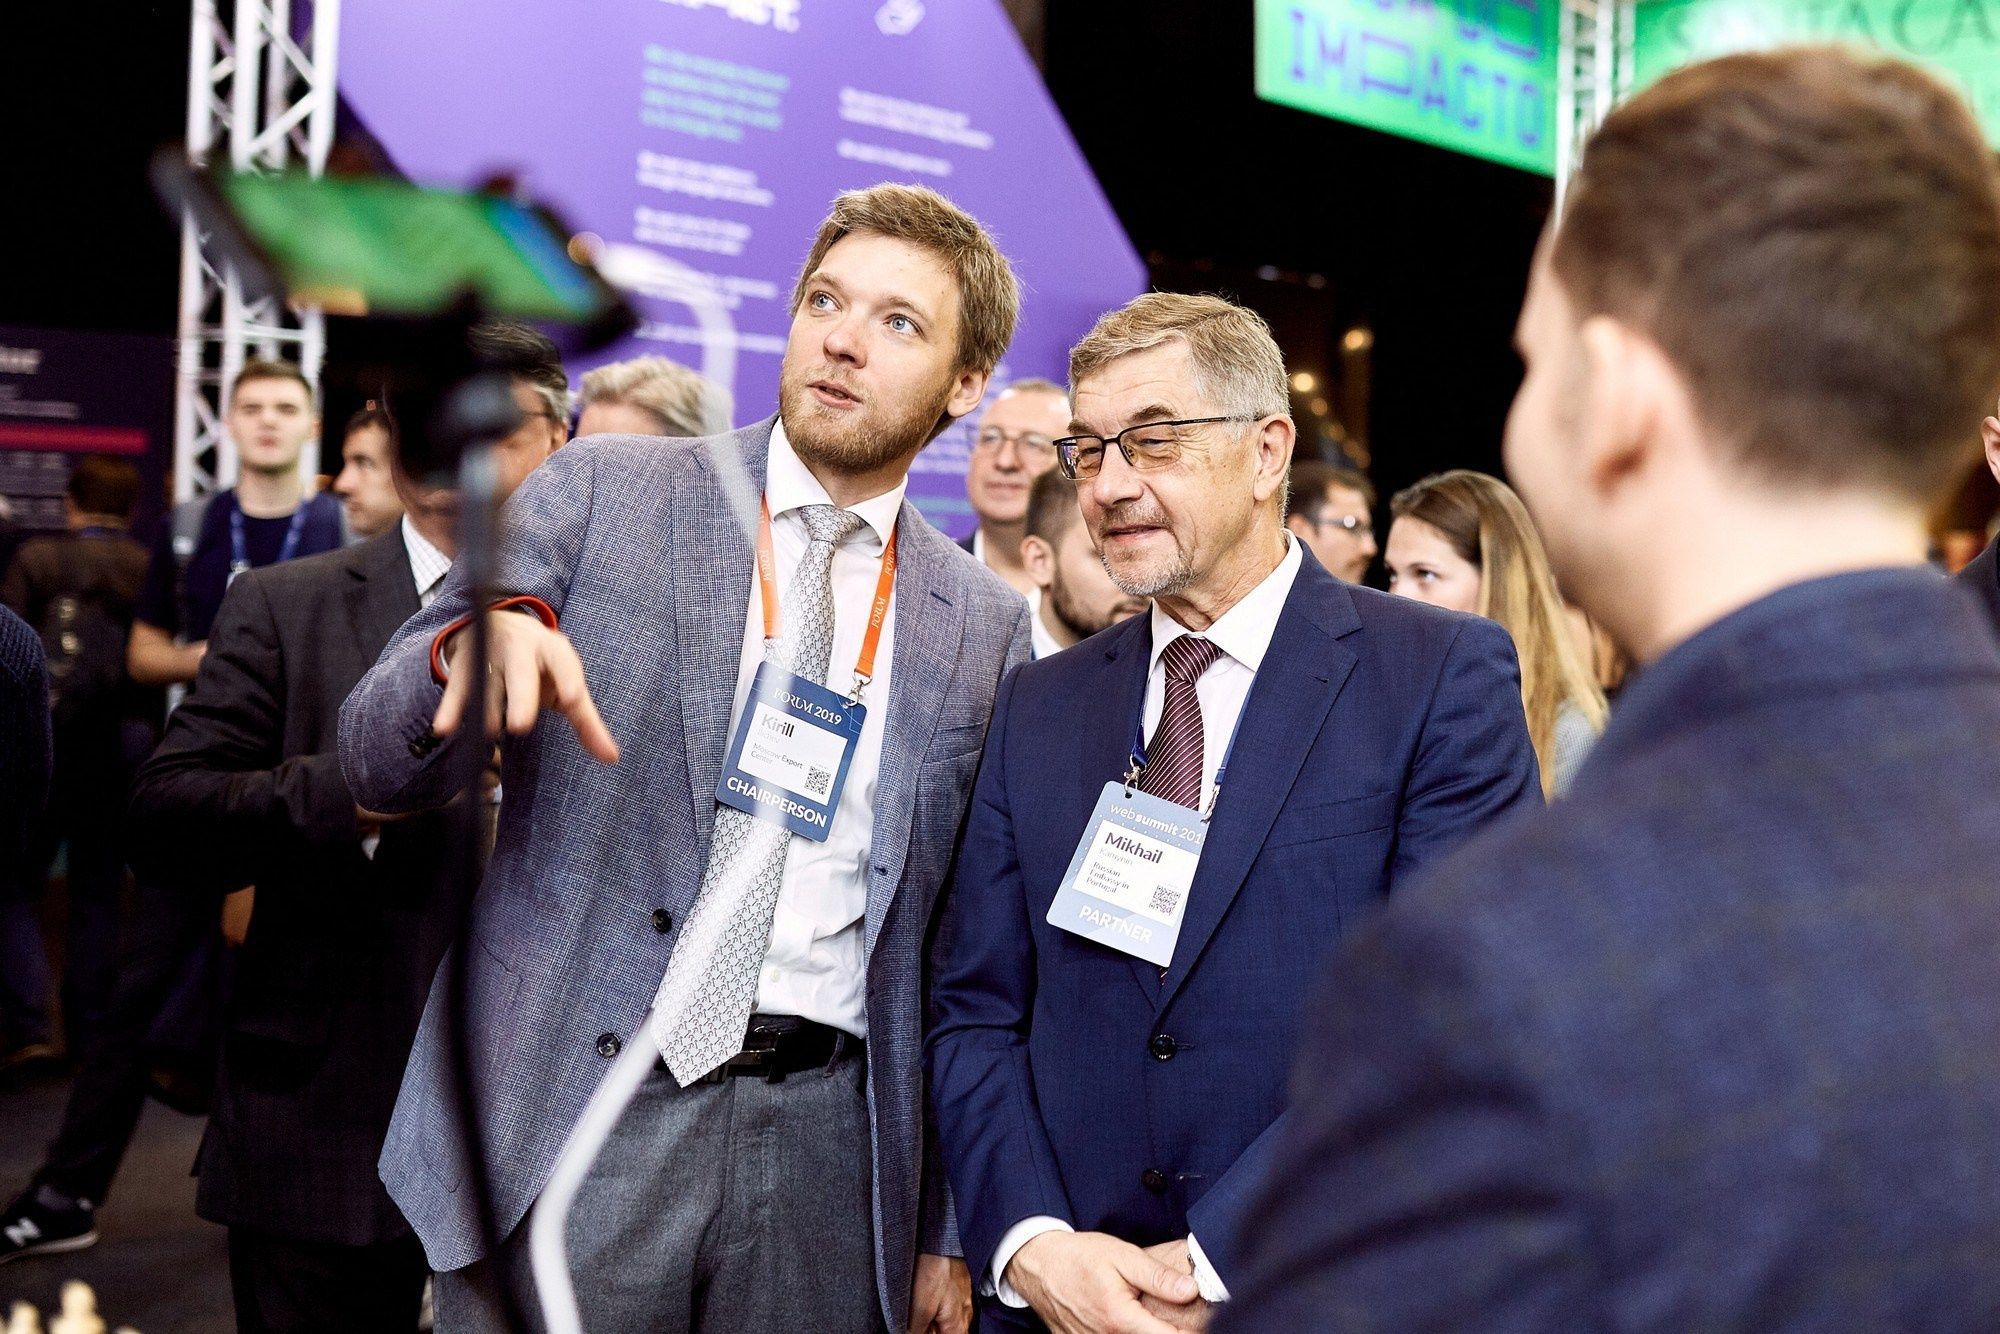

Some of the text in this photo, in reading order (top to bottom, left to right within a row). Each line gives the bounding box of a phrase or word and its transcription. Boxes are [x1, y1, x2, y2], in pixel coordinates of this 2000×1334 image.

[1290, 8, 1546, 148] IMPACTO
[760, 549, 773, 581] FORUM
[872, 595, 886, 629] FORUM
[773, 687, 843, 726] FORUM 2019
[761, 713, 795, 738] Kirill
[750, 750, 773, 765] Center
[753, 742, 781, 759] Moscow
[781, 754, 803, 769] Export
[726, 776, 828, 828] CHAIRPERSON
[1105, 832, 1163, 864] Mikhail
[1179, 827, 1205, 845] 201
[1089, 869, 1121, 887] Embassy
[1093, 861, 1121, 877] Russian
[1086, 876, 1118, 894] Portugal
[1078, 904, 1153, 945] PARTNER
